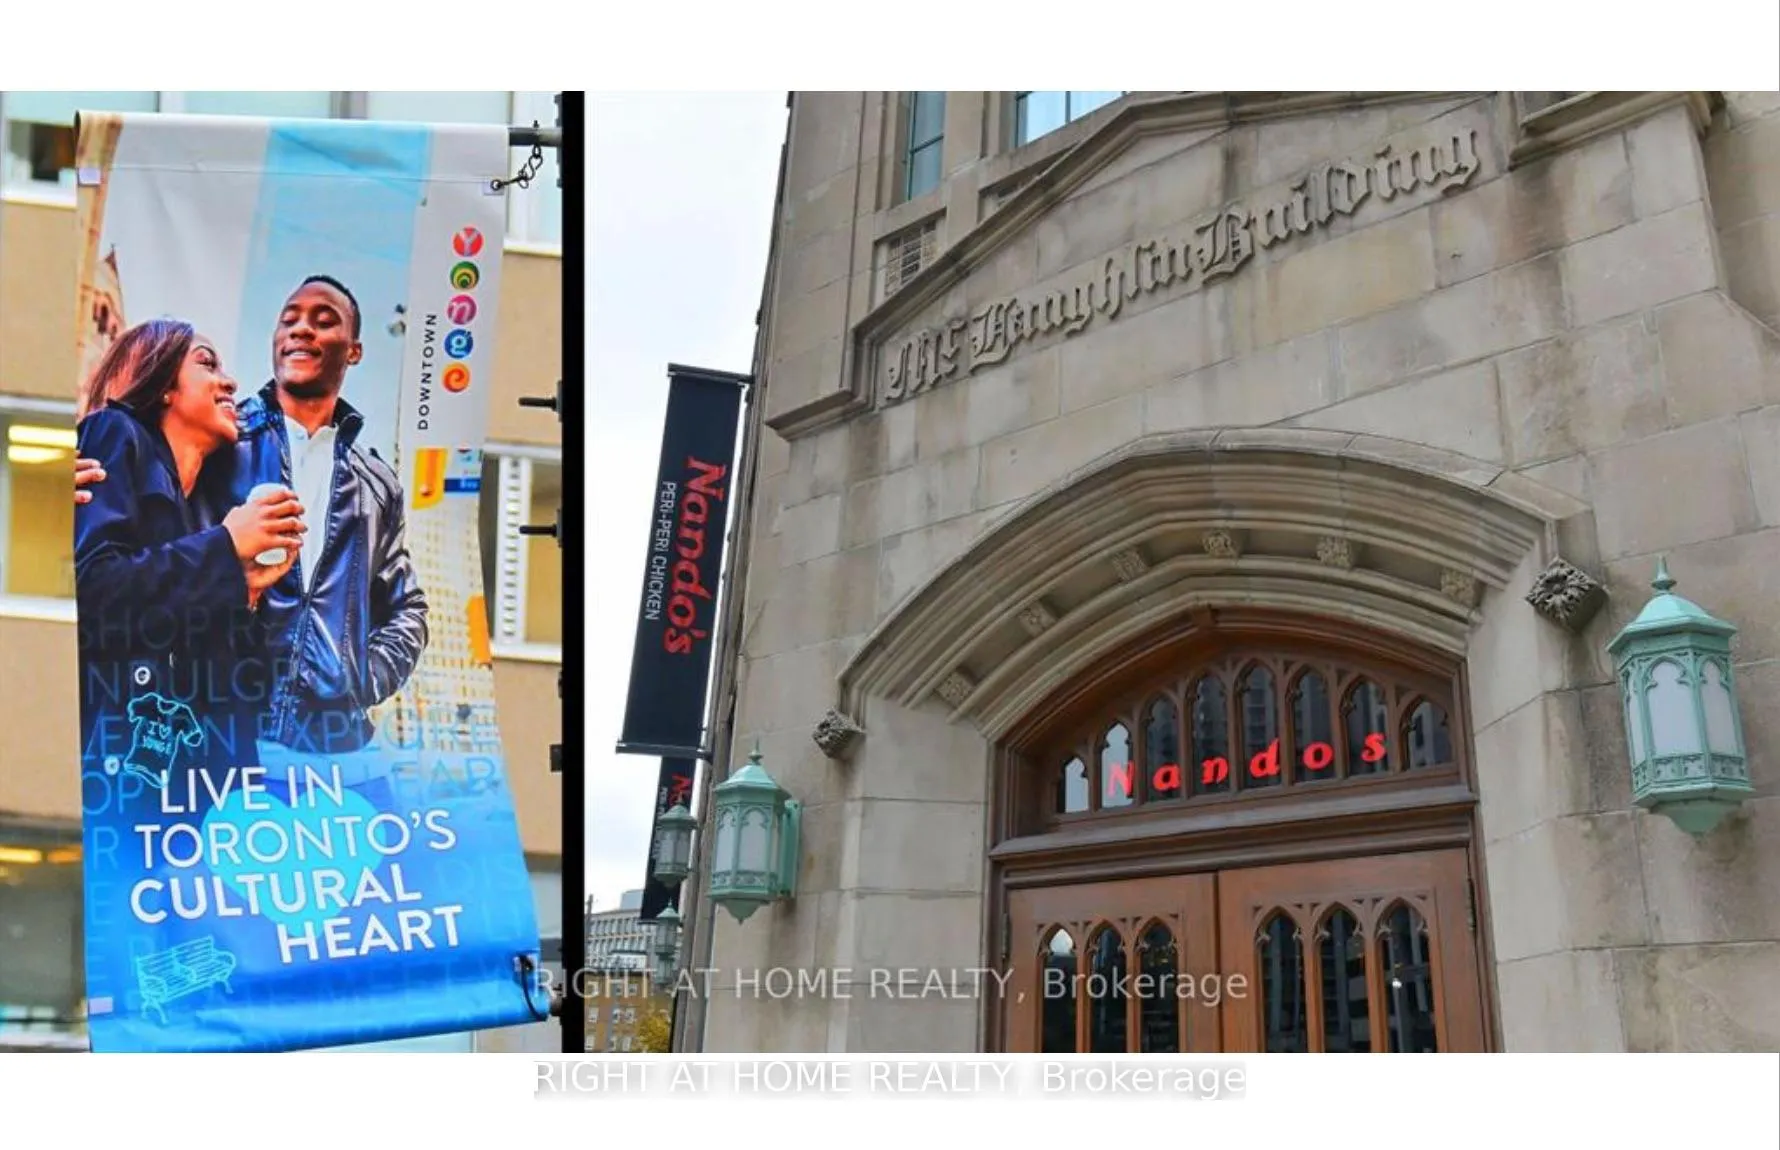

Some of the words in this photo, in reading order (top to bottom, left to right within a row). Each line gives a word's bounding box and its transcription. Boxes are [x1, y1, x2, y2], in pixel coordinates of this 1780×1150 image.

[1196, 129, 1481, 287] Building
[417, 313, 437, 431] DOWNTOWN
[653, 480, 676, 553] PERI-PERI
[644, 554, 668, 621] CHICKEN
[661, 455, 728, 655] Nando's
[160, 768, 270, 813] LIVE
[287, 764, 344, 809] IN
[1107, 732, 1388, 798] Nandos
[134, 809, 457, 870] TORONTO'S
[130, 862, 423, 924] CULTURAL
[277, 903, 463, 964] HEART
